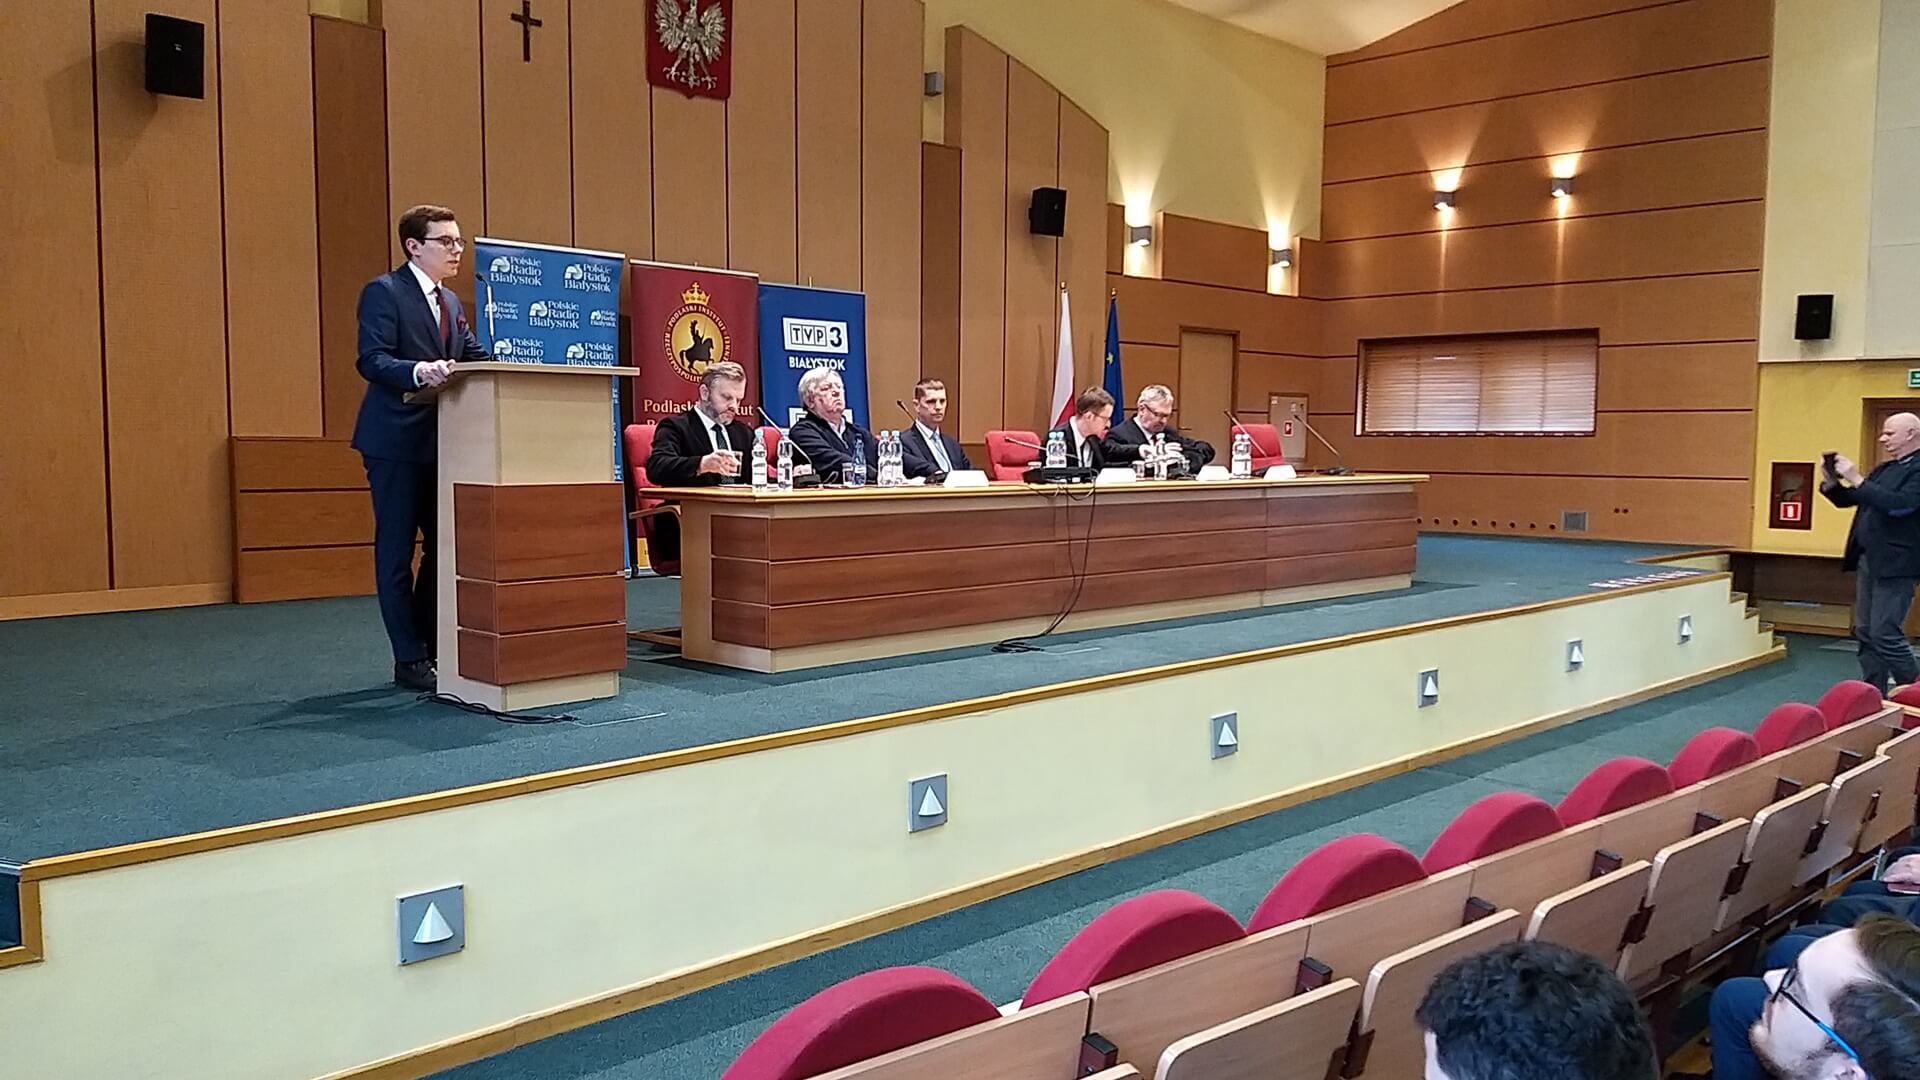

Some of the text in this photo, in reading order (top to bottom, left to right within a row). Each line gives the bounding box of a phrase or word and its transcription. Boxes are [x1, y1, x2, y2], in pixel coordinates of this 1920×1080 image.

[510, 256, 541, 267] Polskie
[511, 264, 542, 276] Radio
[583, 264, 612, 274] Polskie
[583, 272, 611, 283] Radio
[548, 300, 579, 310] Polskie
[548, 308, 579, 319] Radio
[792, 326, 842, 347] TVP 3
[513, 338, 543, 348] Polskie
[585, 342, 614, 352] Polskie
[513, 346, 544, 357] Radio
[585, 350, 614, 361] Radio
[789, 356, 846, 371] BIAŁYSTOK
[643, 399, 697, 414] Podlask
